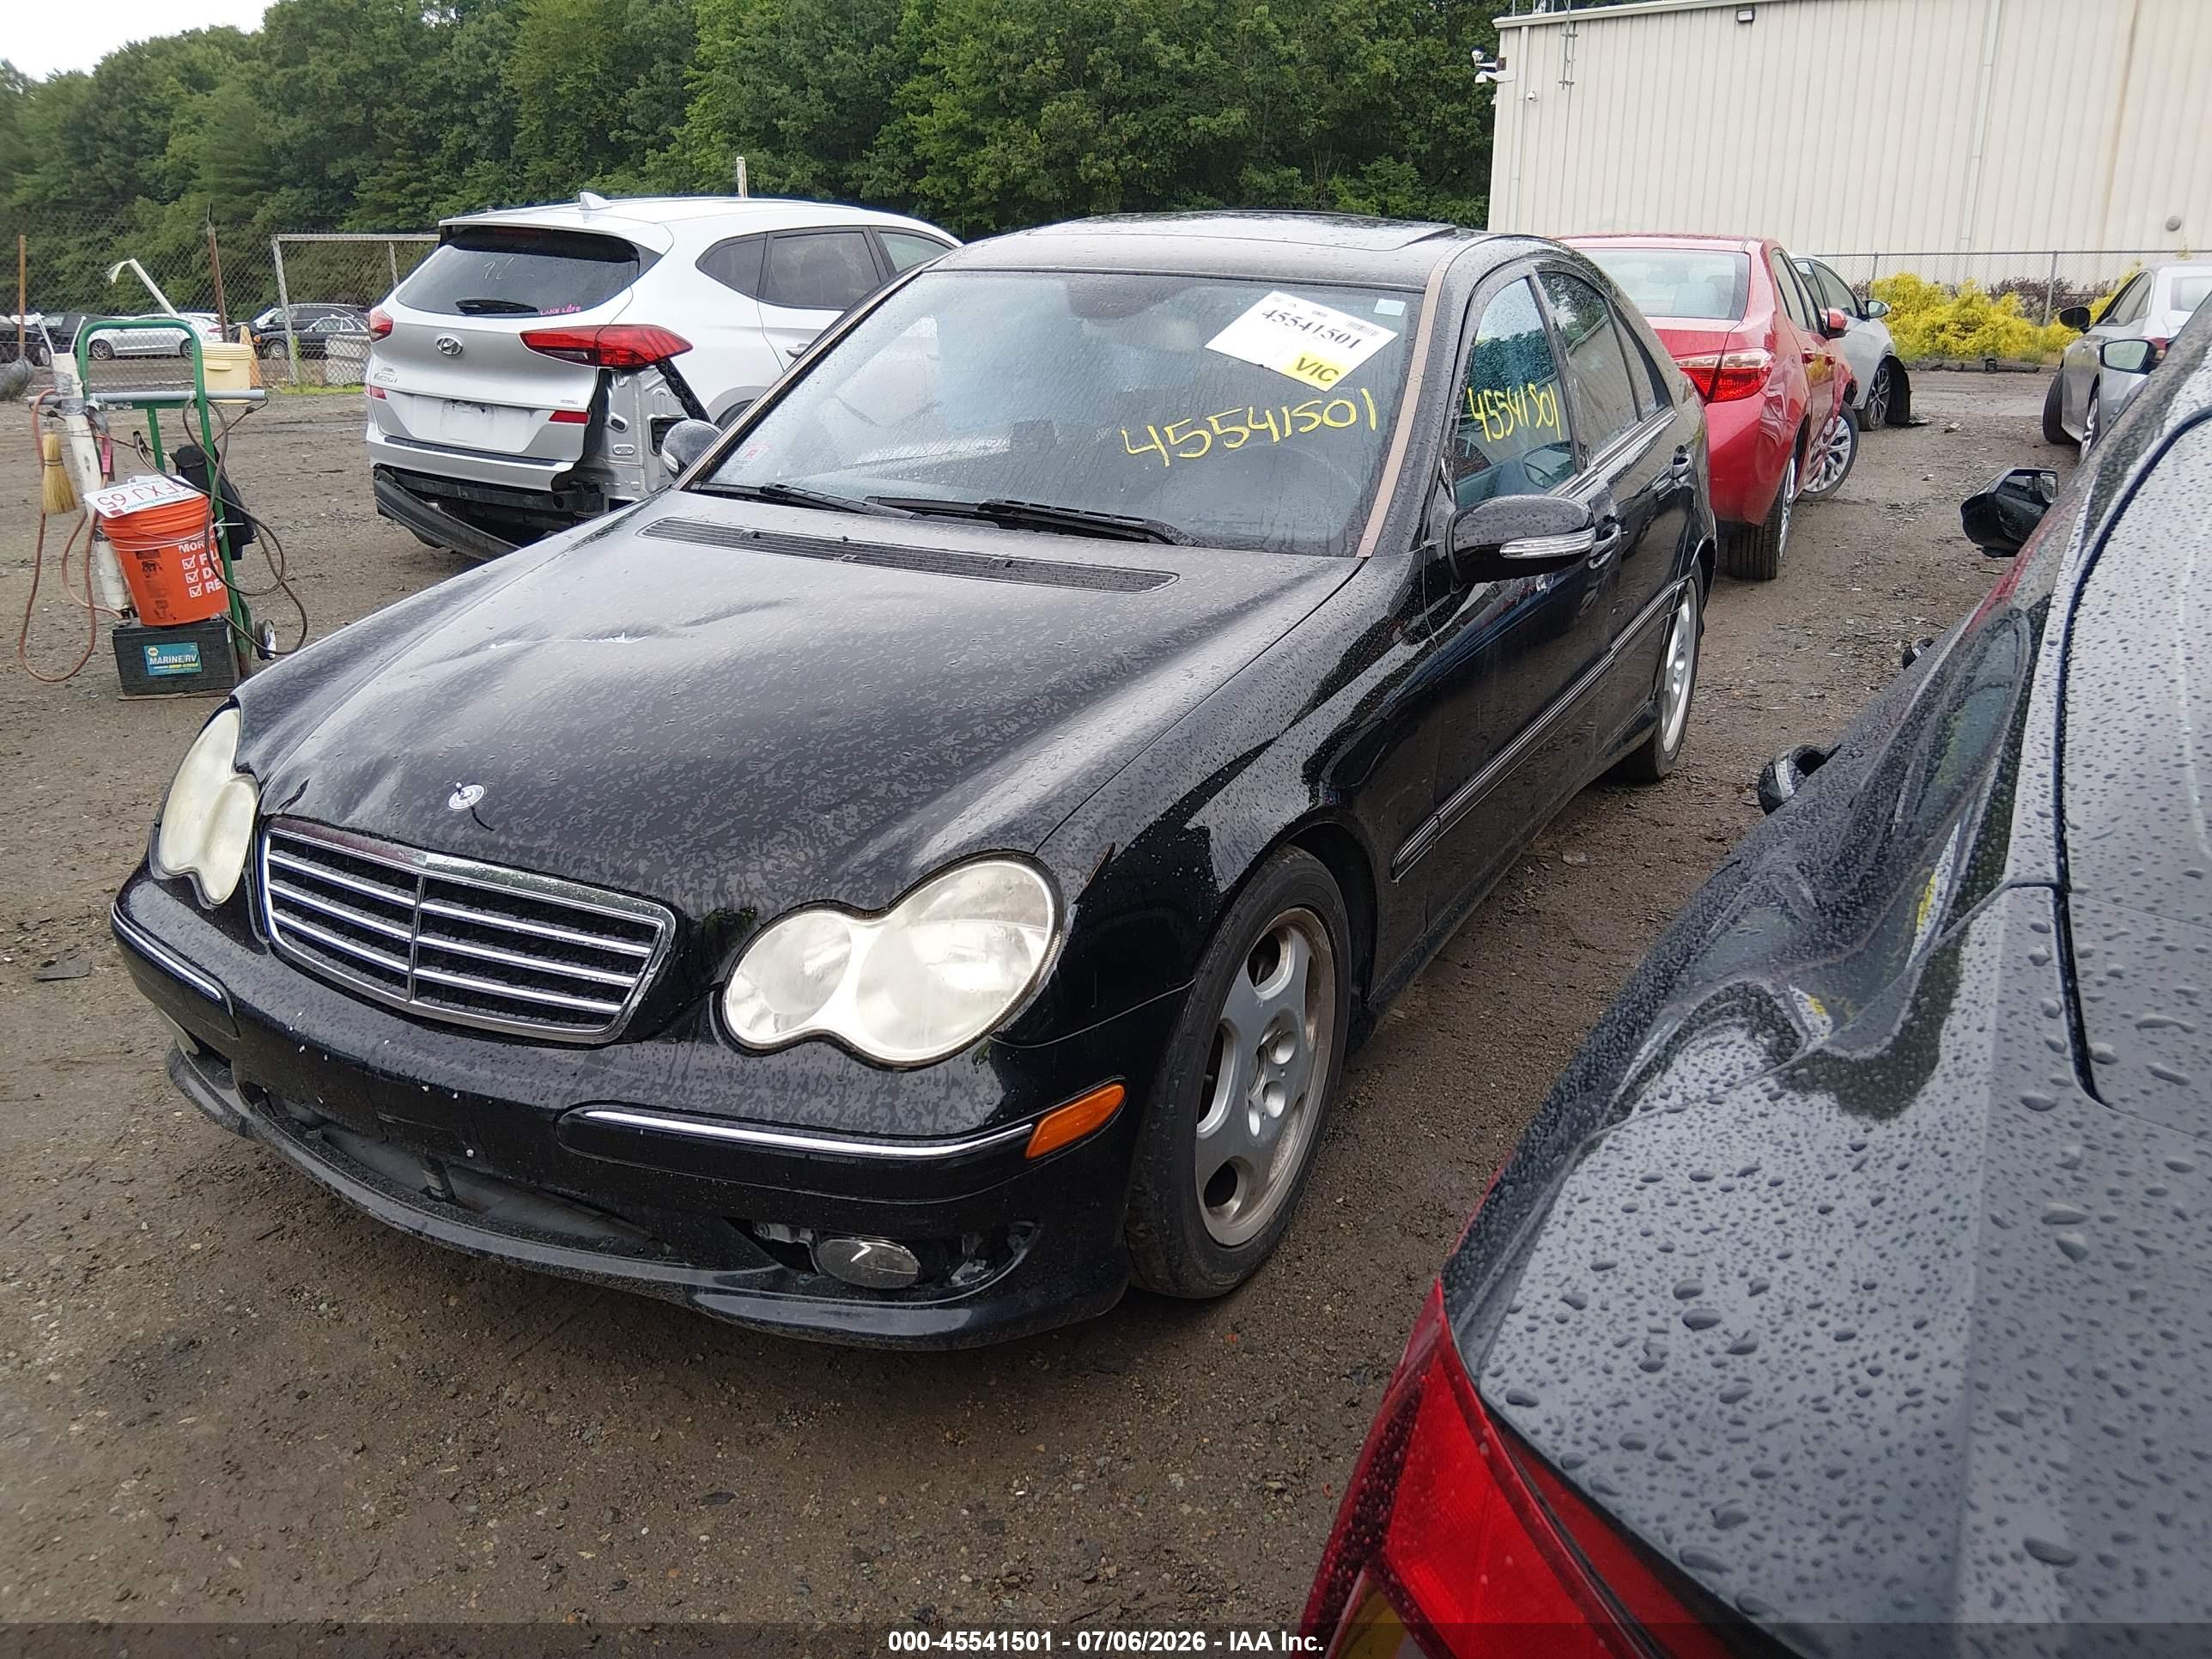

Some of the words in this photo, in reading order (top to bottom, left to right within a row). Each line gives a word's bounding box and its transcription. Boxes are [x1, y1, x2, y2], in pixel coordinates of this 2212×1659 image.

[1262, 309, 1363, 349] 45541501
[1296, 357, 1339, 382] VIC
[1121, 388, 1376, 467] 45541501
[1468, 383, 1563, 442] 45541501
